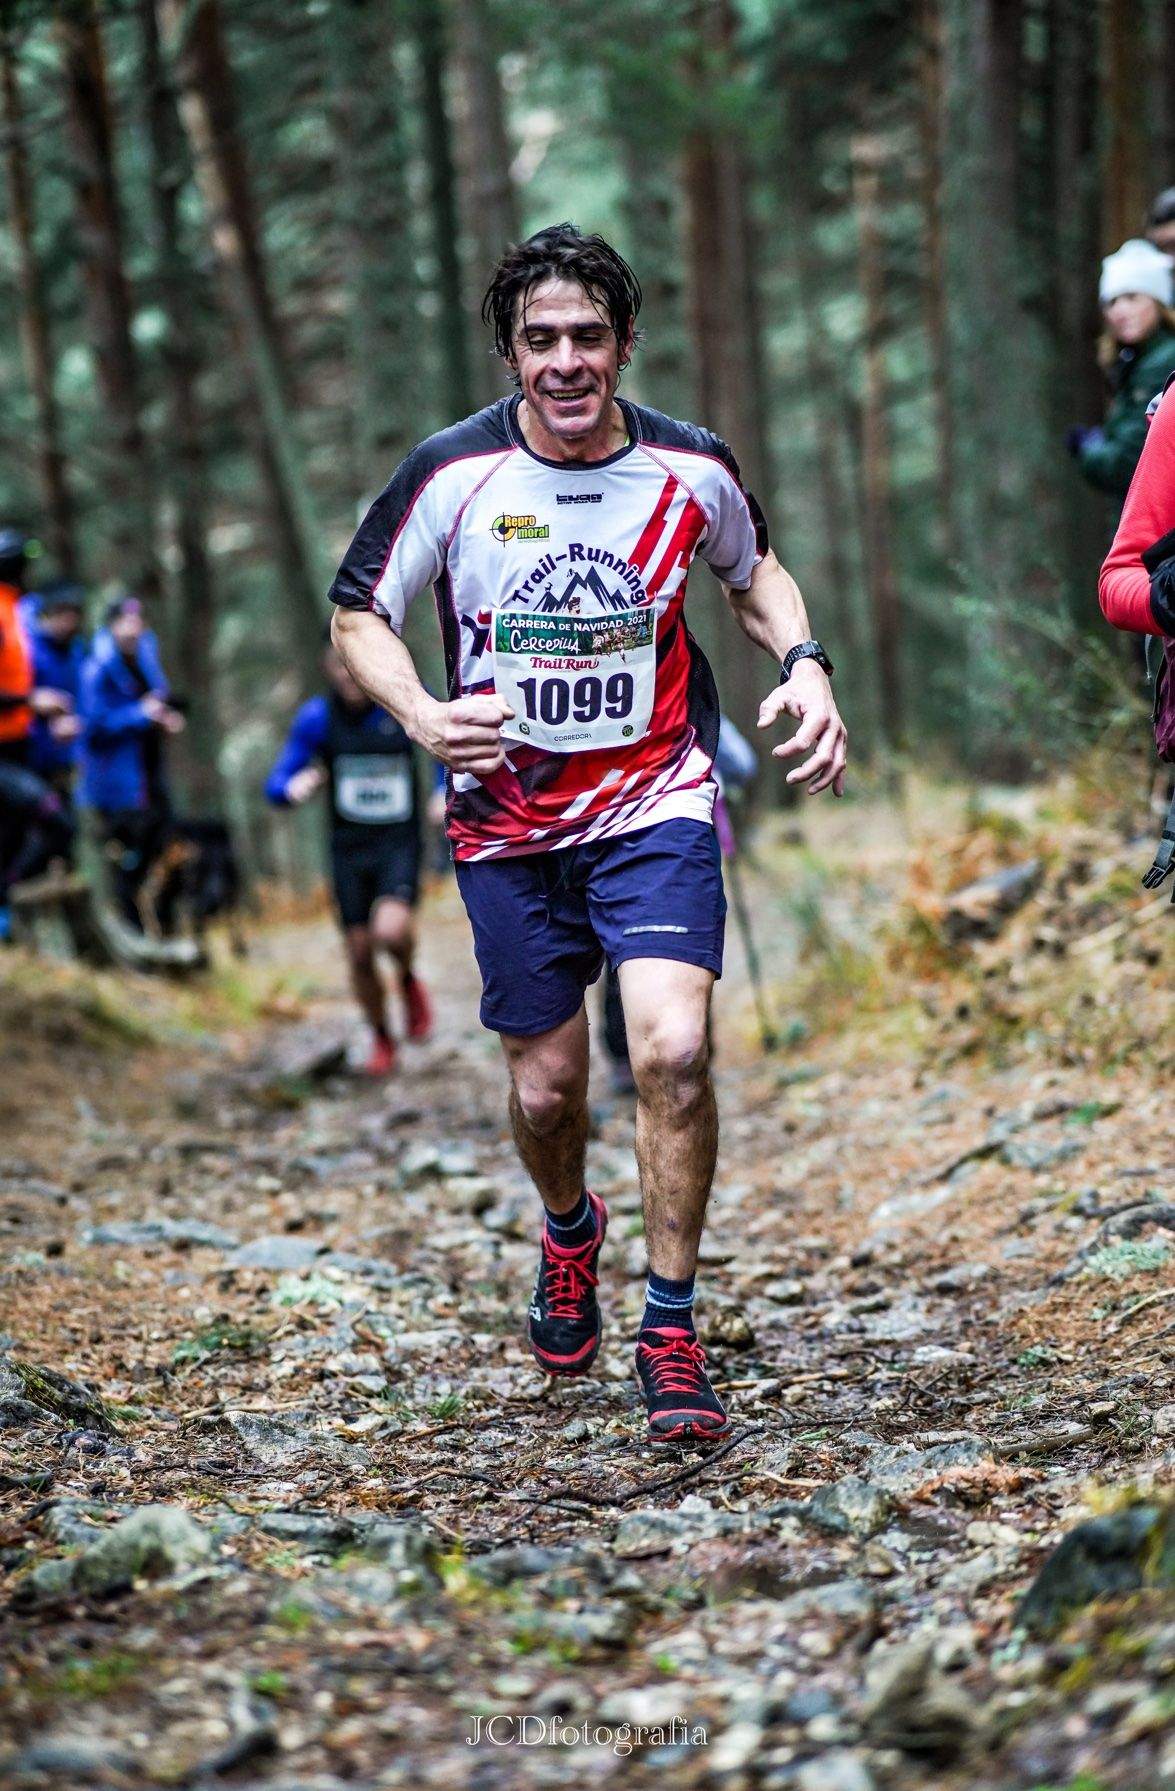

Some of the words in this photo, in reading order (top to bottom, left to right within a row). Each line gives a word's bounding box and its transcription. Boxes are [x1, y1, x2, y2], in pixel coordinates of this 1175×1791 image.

[504, 515, 536, 528] Repro
[517, 525, 550, 539] moral
[512, 542, 648, 606] Trail-Running
[502, 618, 556, 631] CARRERA
[573, 620, 624, 632] NAVIDAD
[627, 614, 647, 627] 2021
[530, 656, 563, 669] Trail
[563, 658, 600, 671] Run
[516, 672, 634, 726] 1099
